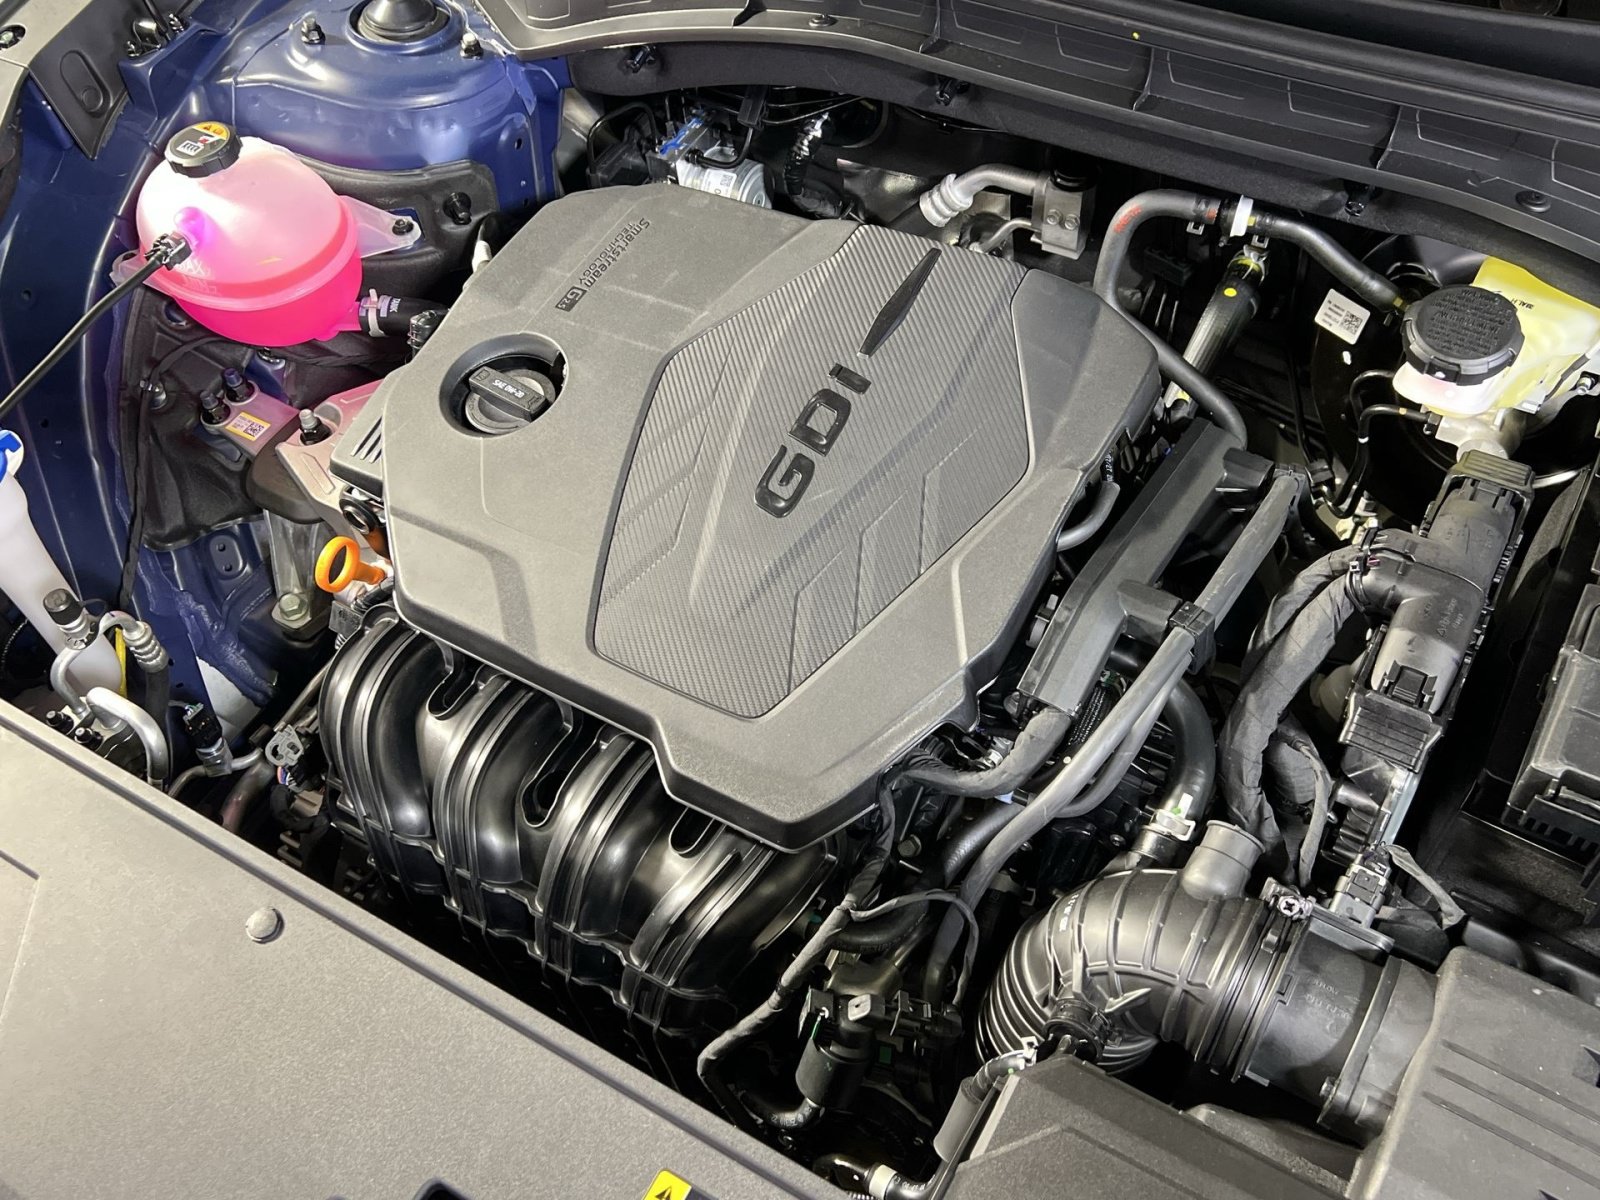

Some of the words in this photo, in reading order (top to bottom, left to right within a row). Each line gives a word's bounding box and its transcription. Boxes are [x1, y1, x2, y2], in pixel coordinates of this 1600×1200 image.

[579, 223, 635, 285] TECHNOLOGY
[584, 217, 650, 288] Smartstream
[492, 379, 507, 389] SAE
[504, 385, 526, 398] 0W-20
